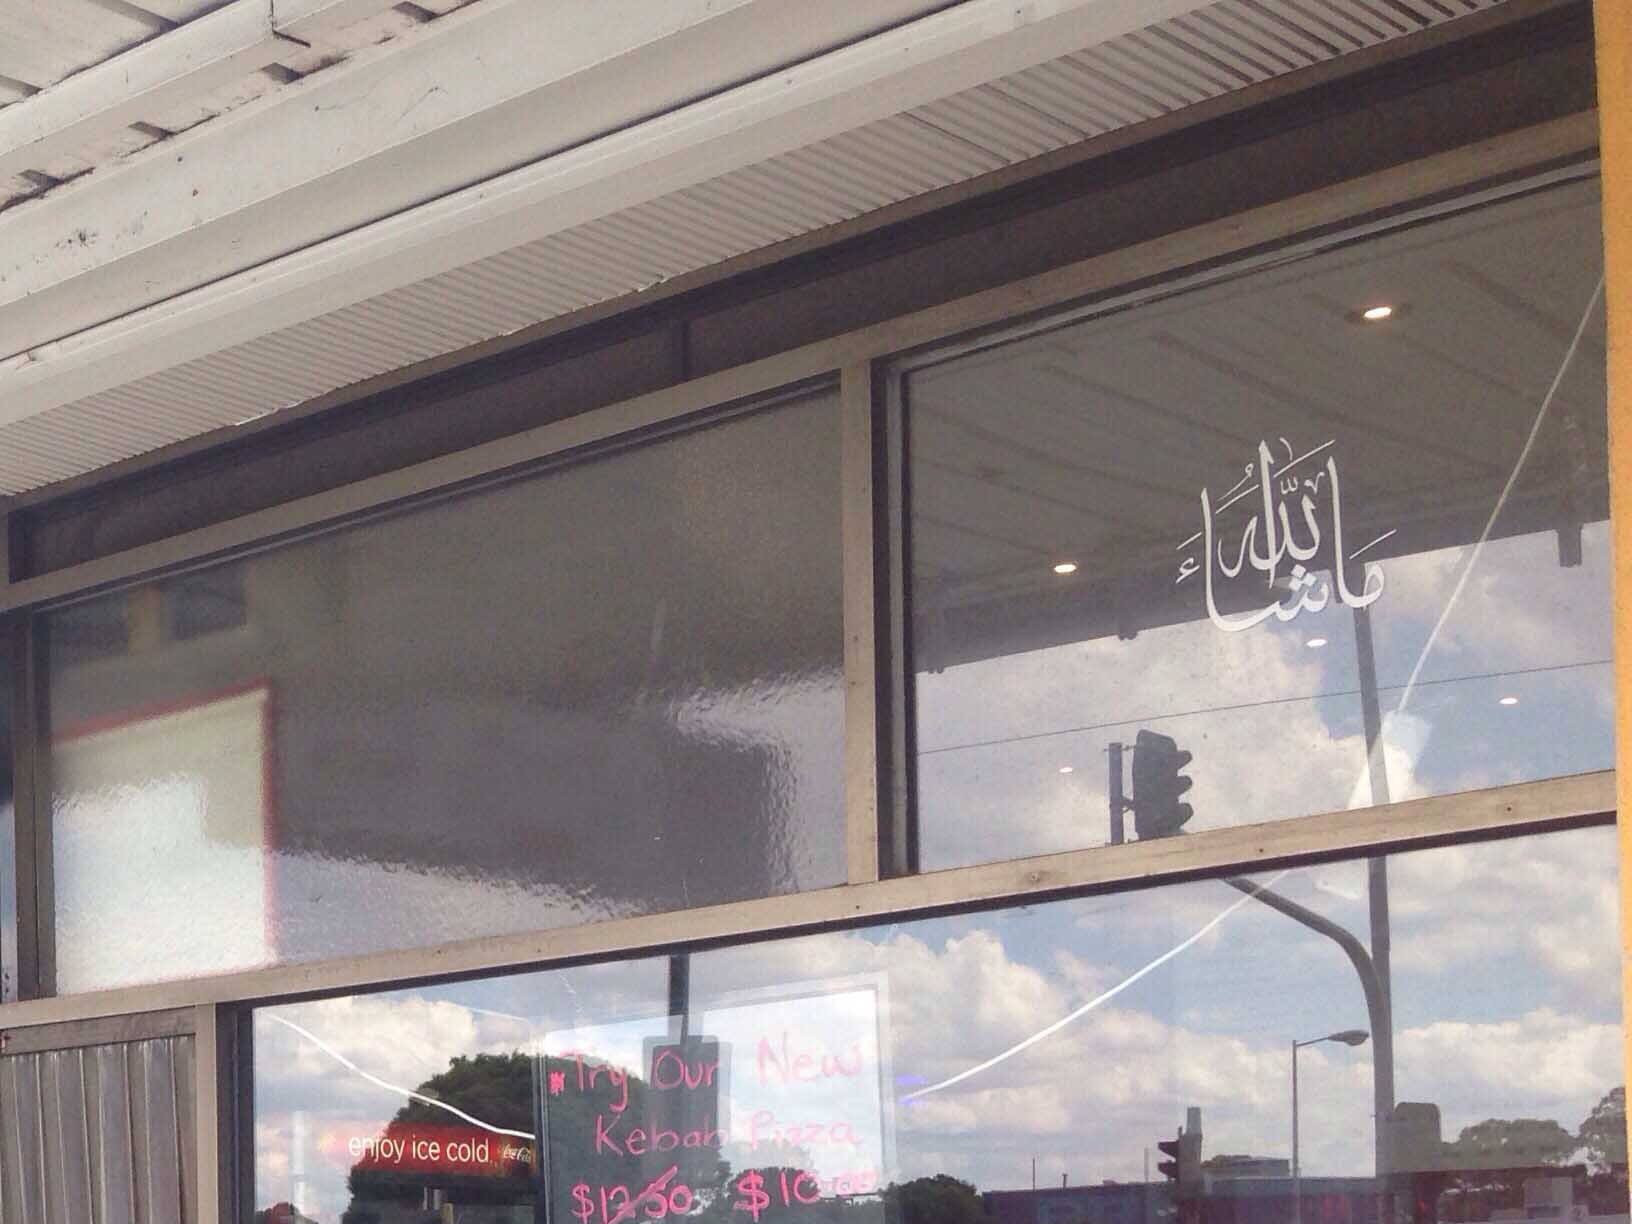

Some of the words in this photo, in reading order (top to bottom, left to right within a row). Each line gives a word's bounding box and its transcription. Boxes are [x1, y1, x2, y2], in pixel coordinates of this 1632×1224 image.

[560, 1049, 630, 1112] Try
[652, 1049, 720, 1090] Our
[755, 1032, 863, 1086] New
[348, 1134, 406, 1164] enjoy
[411, 1134, 442, 1162] ice
[446, 1138, 490, 1164] cold
[594, 1114, 729, 1157] Kebab
[748, 1110, 861, 1150] Pizza
